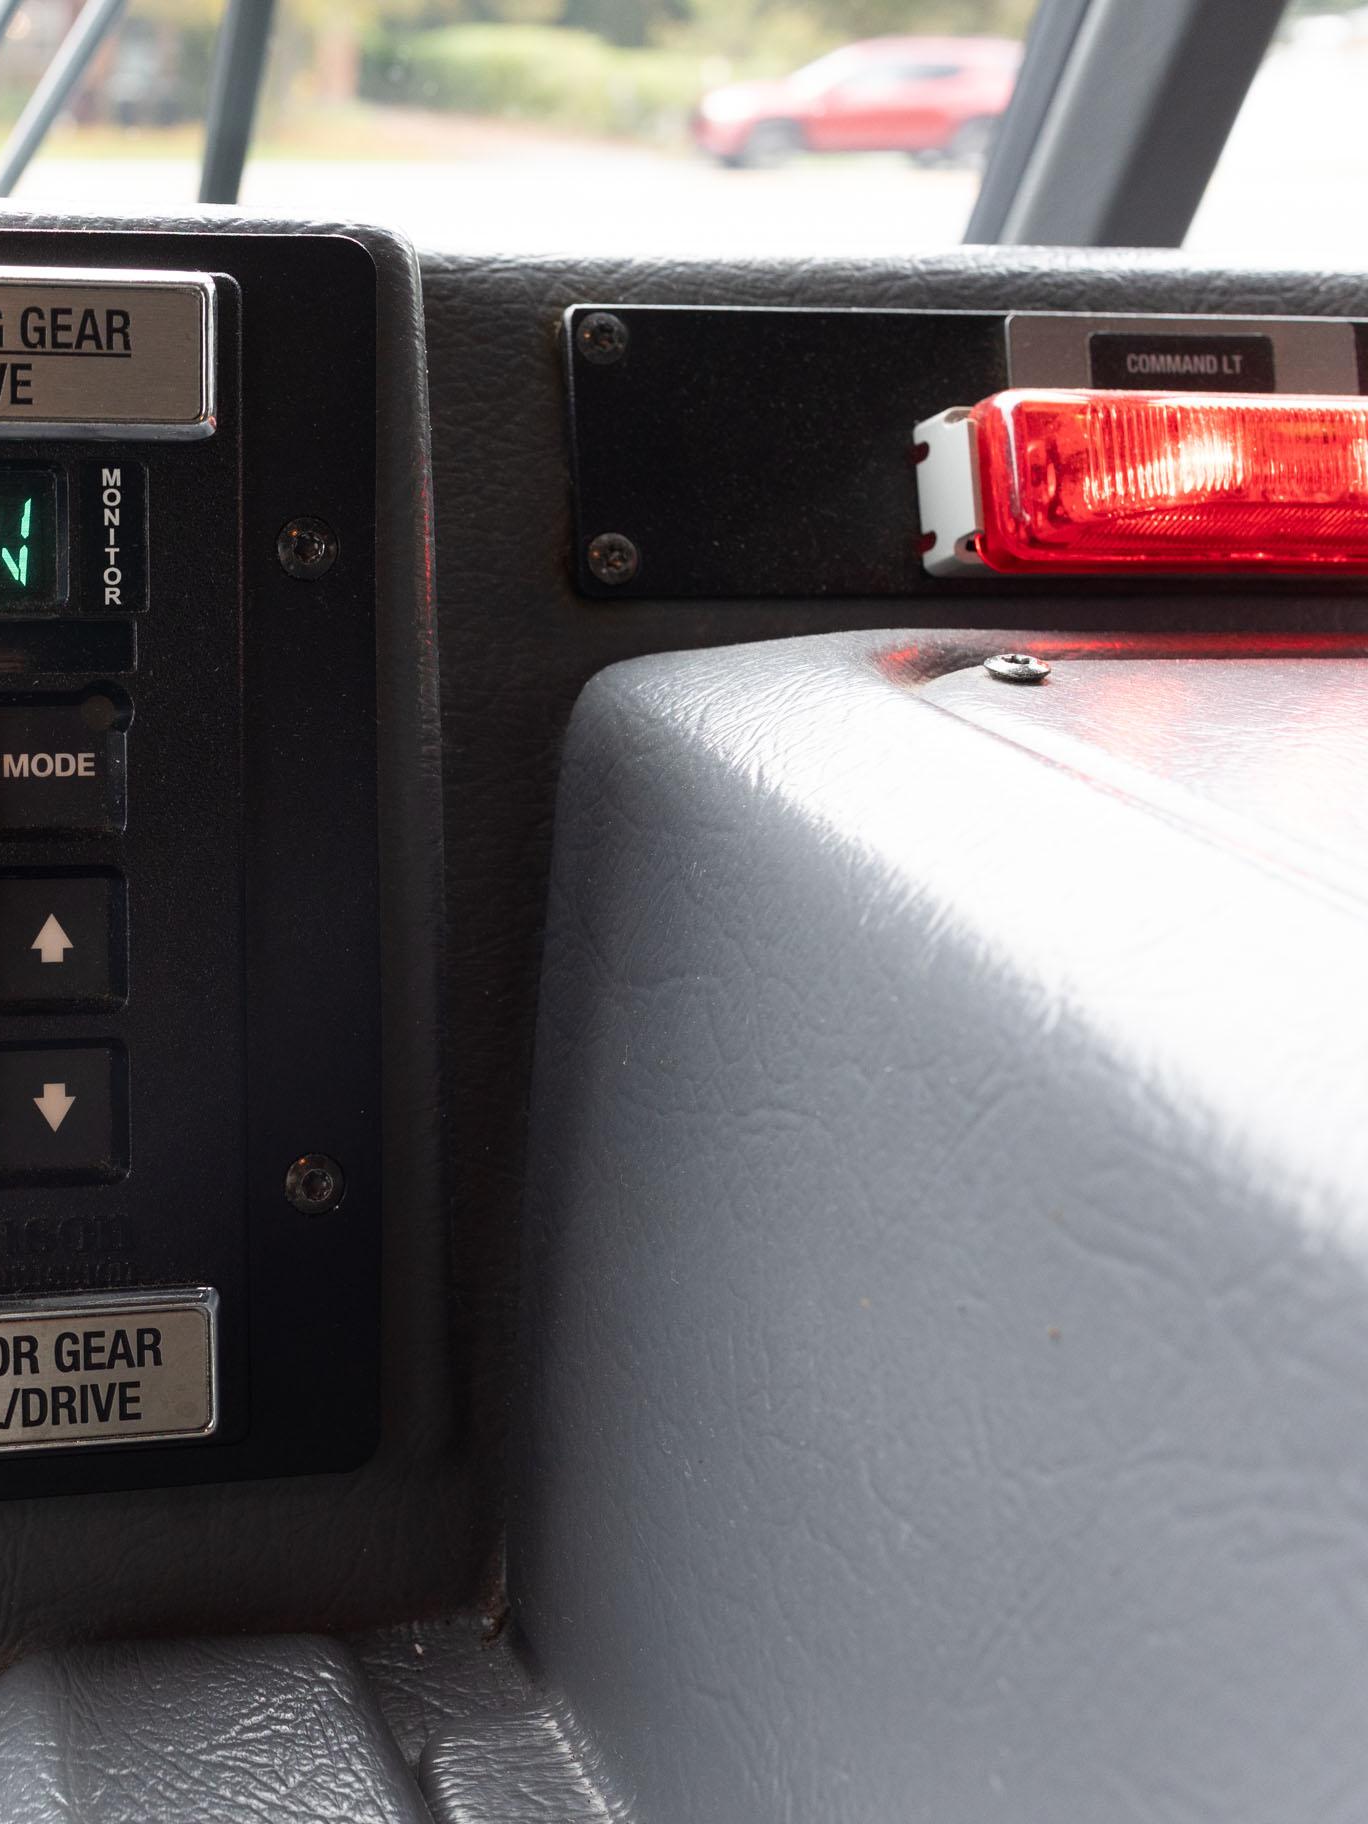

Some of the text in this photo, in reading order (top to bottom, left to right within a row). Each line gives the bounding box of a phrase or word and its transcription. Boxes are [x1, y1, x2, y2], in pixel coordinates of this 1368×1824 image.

[19, 307, 132, 351] GEAR
[1126, 353, 1243, 375] COMMAND LT
[101, 468, 123, 606] MONITOR
[2, 752, 96, 778] MODE
[53, 1327, 163, 1371] GEAR
